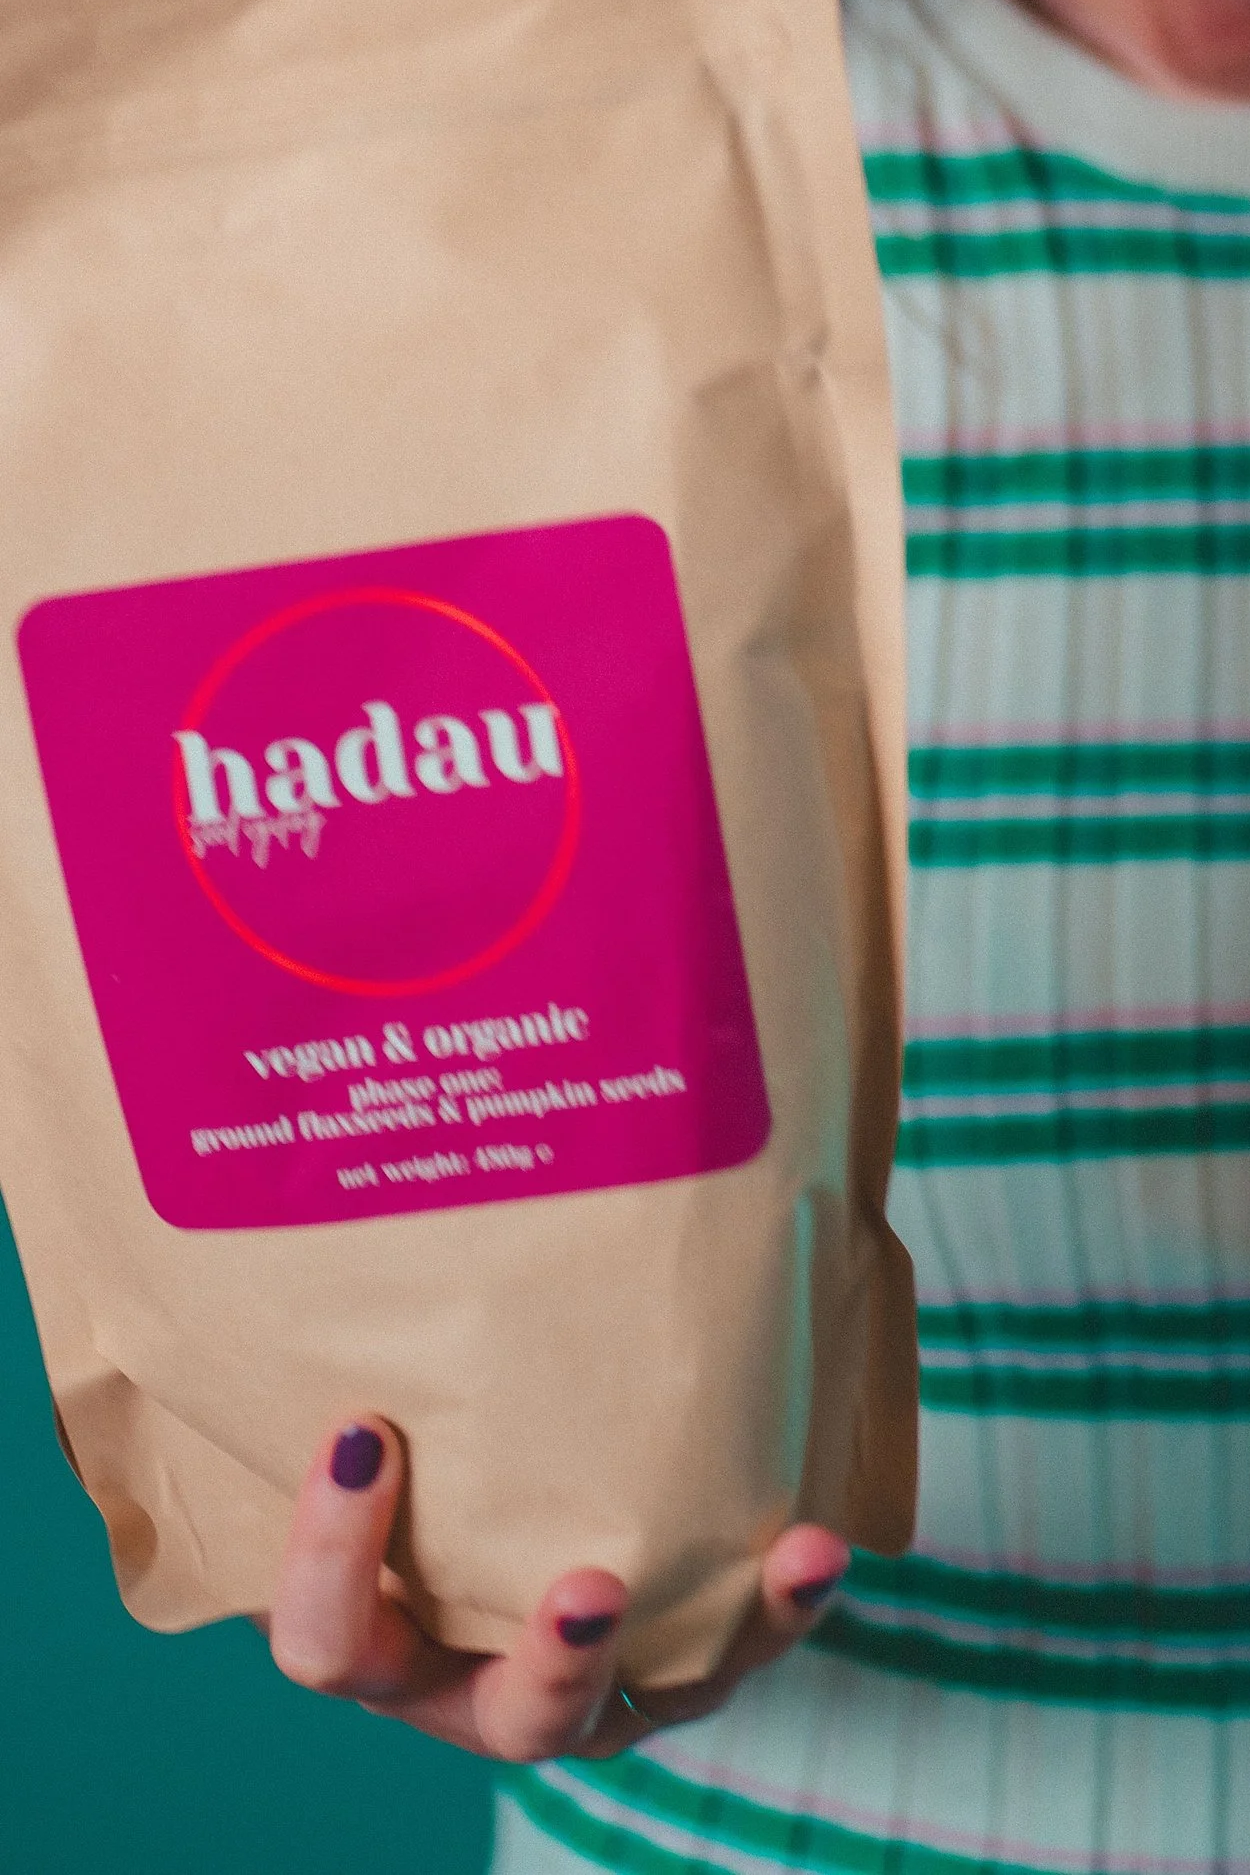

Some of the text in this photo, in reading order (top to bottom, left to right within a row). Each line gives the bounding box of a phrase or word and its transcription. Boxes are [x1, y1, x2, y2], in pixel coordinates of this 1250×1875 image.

[171, 699, 563, 826] hadau
[243, 1001, 590, 1082] vegan & organic
[190, 1114, 296, 1156] ground
[437, 1094, 463, 1124] &
[465, 1080, 598, 1126] pumpkin
[599, 1064, 688, 1104] seeds
[347, 1077, 437, 1113] phase
[336, 1161, 380, 1190] net
